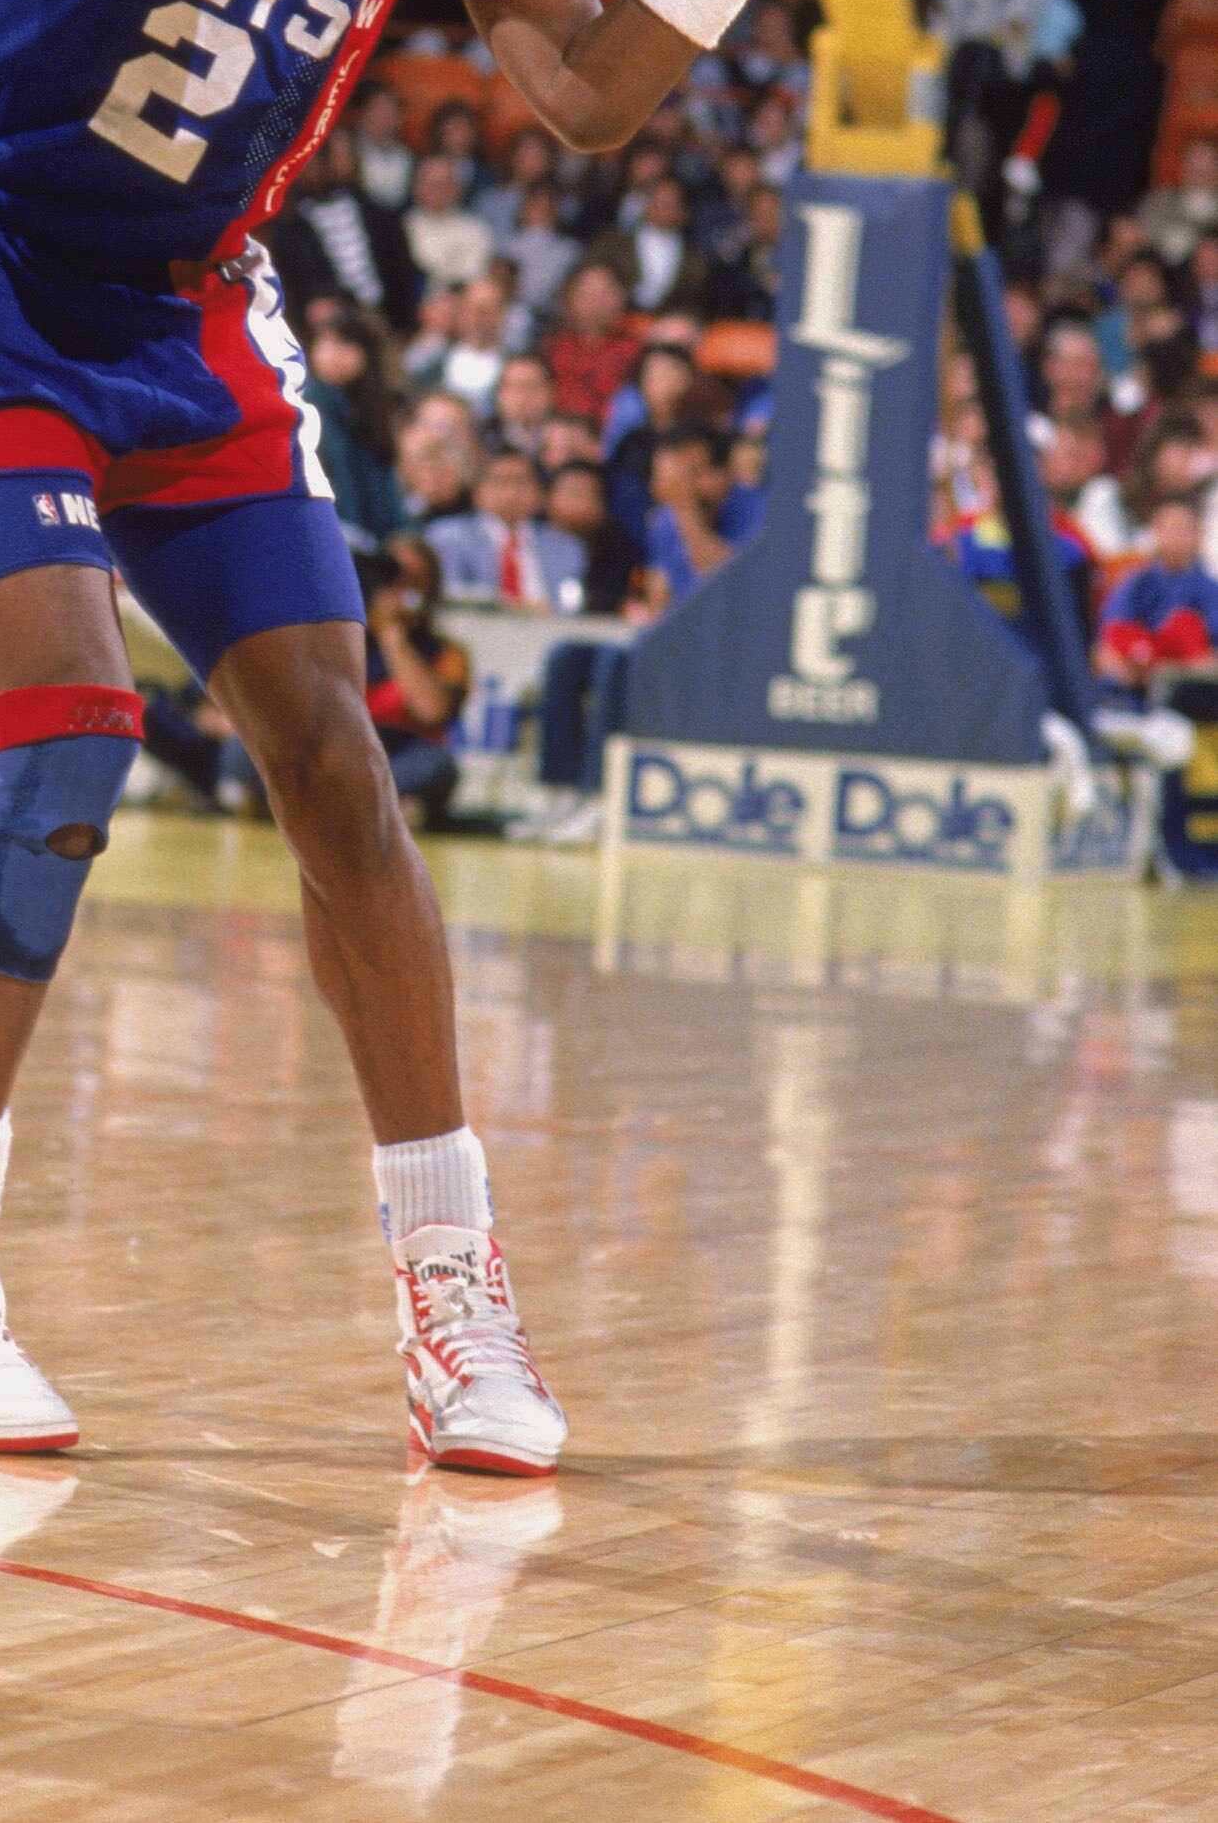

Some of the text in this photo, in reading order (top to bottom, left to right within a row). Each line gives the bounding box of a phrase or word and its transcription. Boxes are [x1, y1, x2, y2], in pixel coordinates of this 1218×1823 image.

[87, 0, 256, 186] 2
[629, 752, 806, 835] Dole
[835, 770, 1014, 850] Dole
